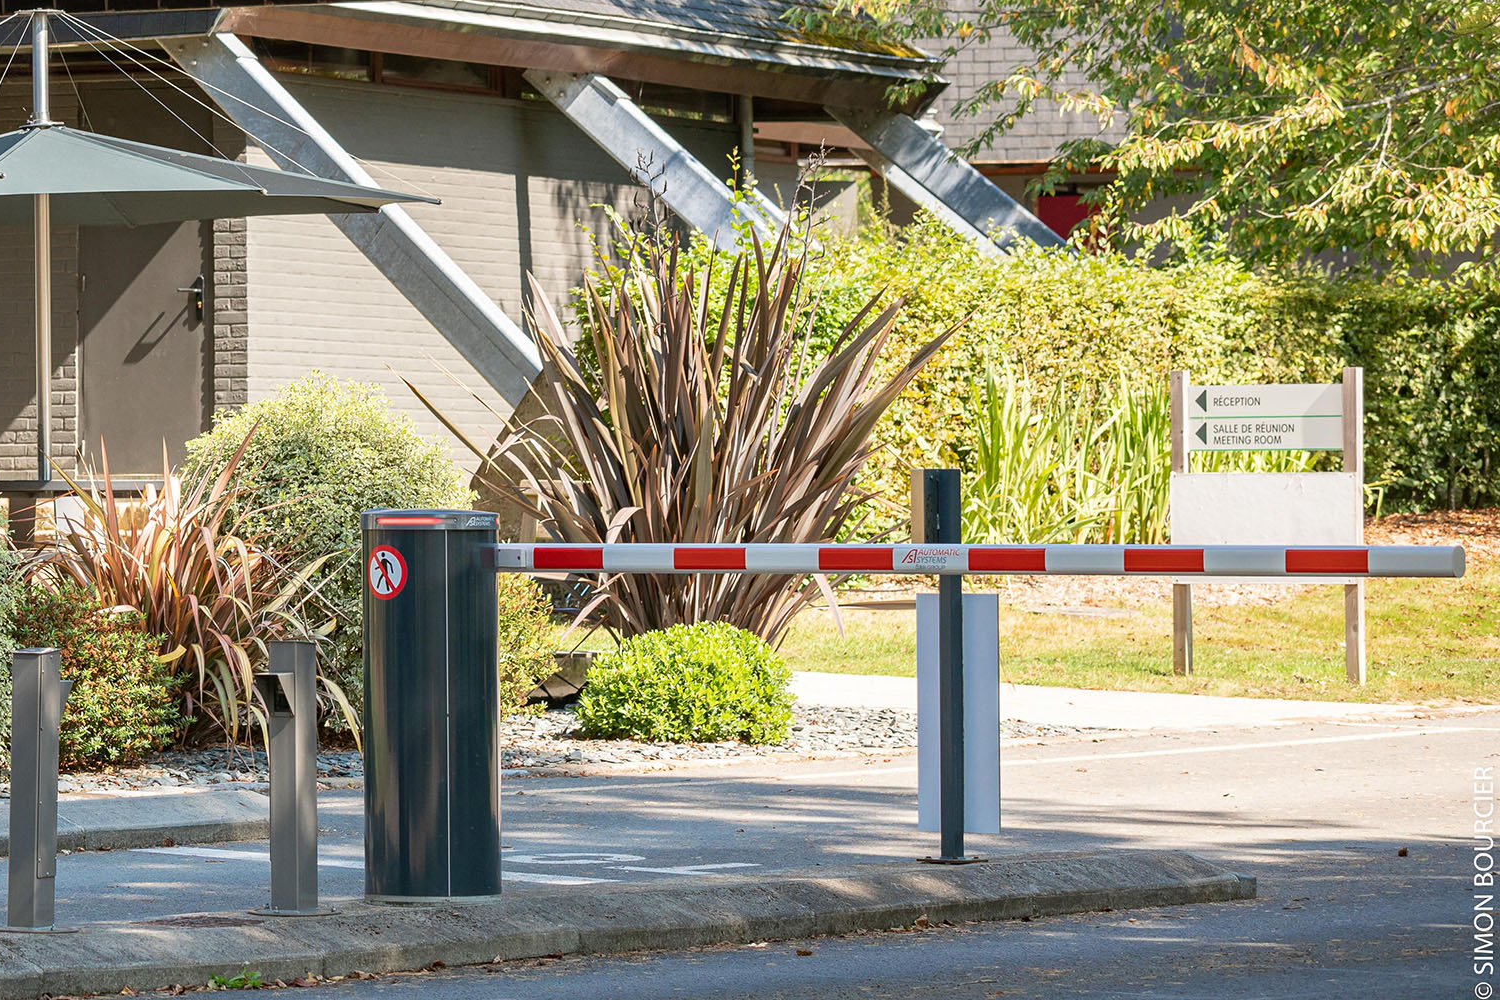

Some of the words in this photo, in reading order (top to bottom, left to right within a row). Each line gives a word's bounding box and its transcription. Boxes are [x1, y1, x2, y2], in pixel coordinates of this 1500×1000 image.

[1213, 395, 1261, 407] RÉCEPTION
[1213, 424, 1238, 434] SALLE
[1241, 424, 1253, 434] DE
[1255, 421, 1295, 433] RÉUNION
[1213, 435, 1252, 445] MEETING
[1255, 435, 1282, 445] ROOM
[918, 548, 960, 556] AUTOMATIC
[916, 556, 947, 564] SYSTEMS
